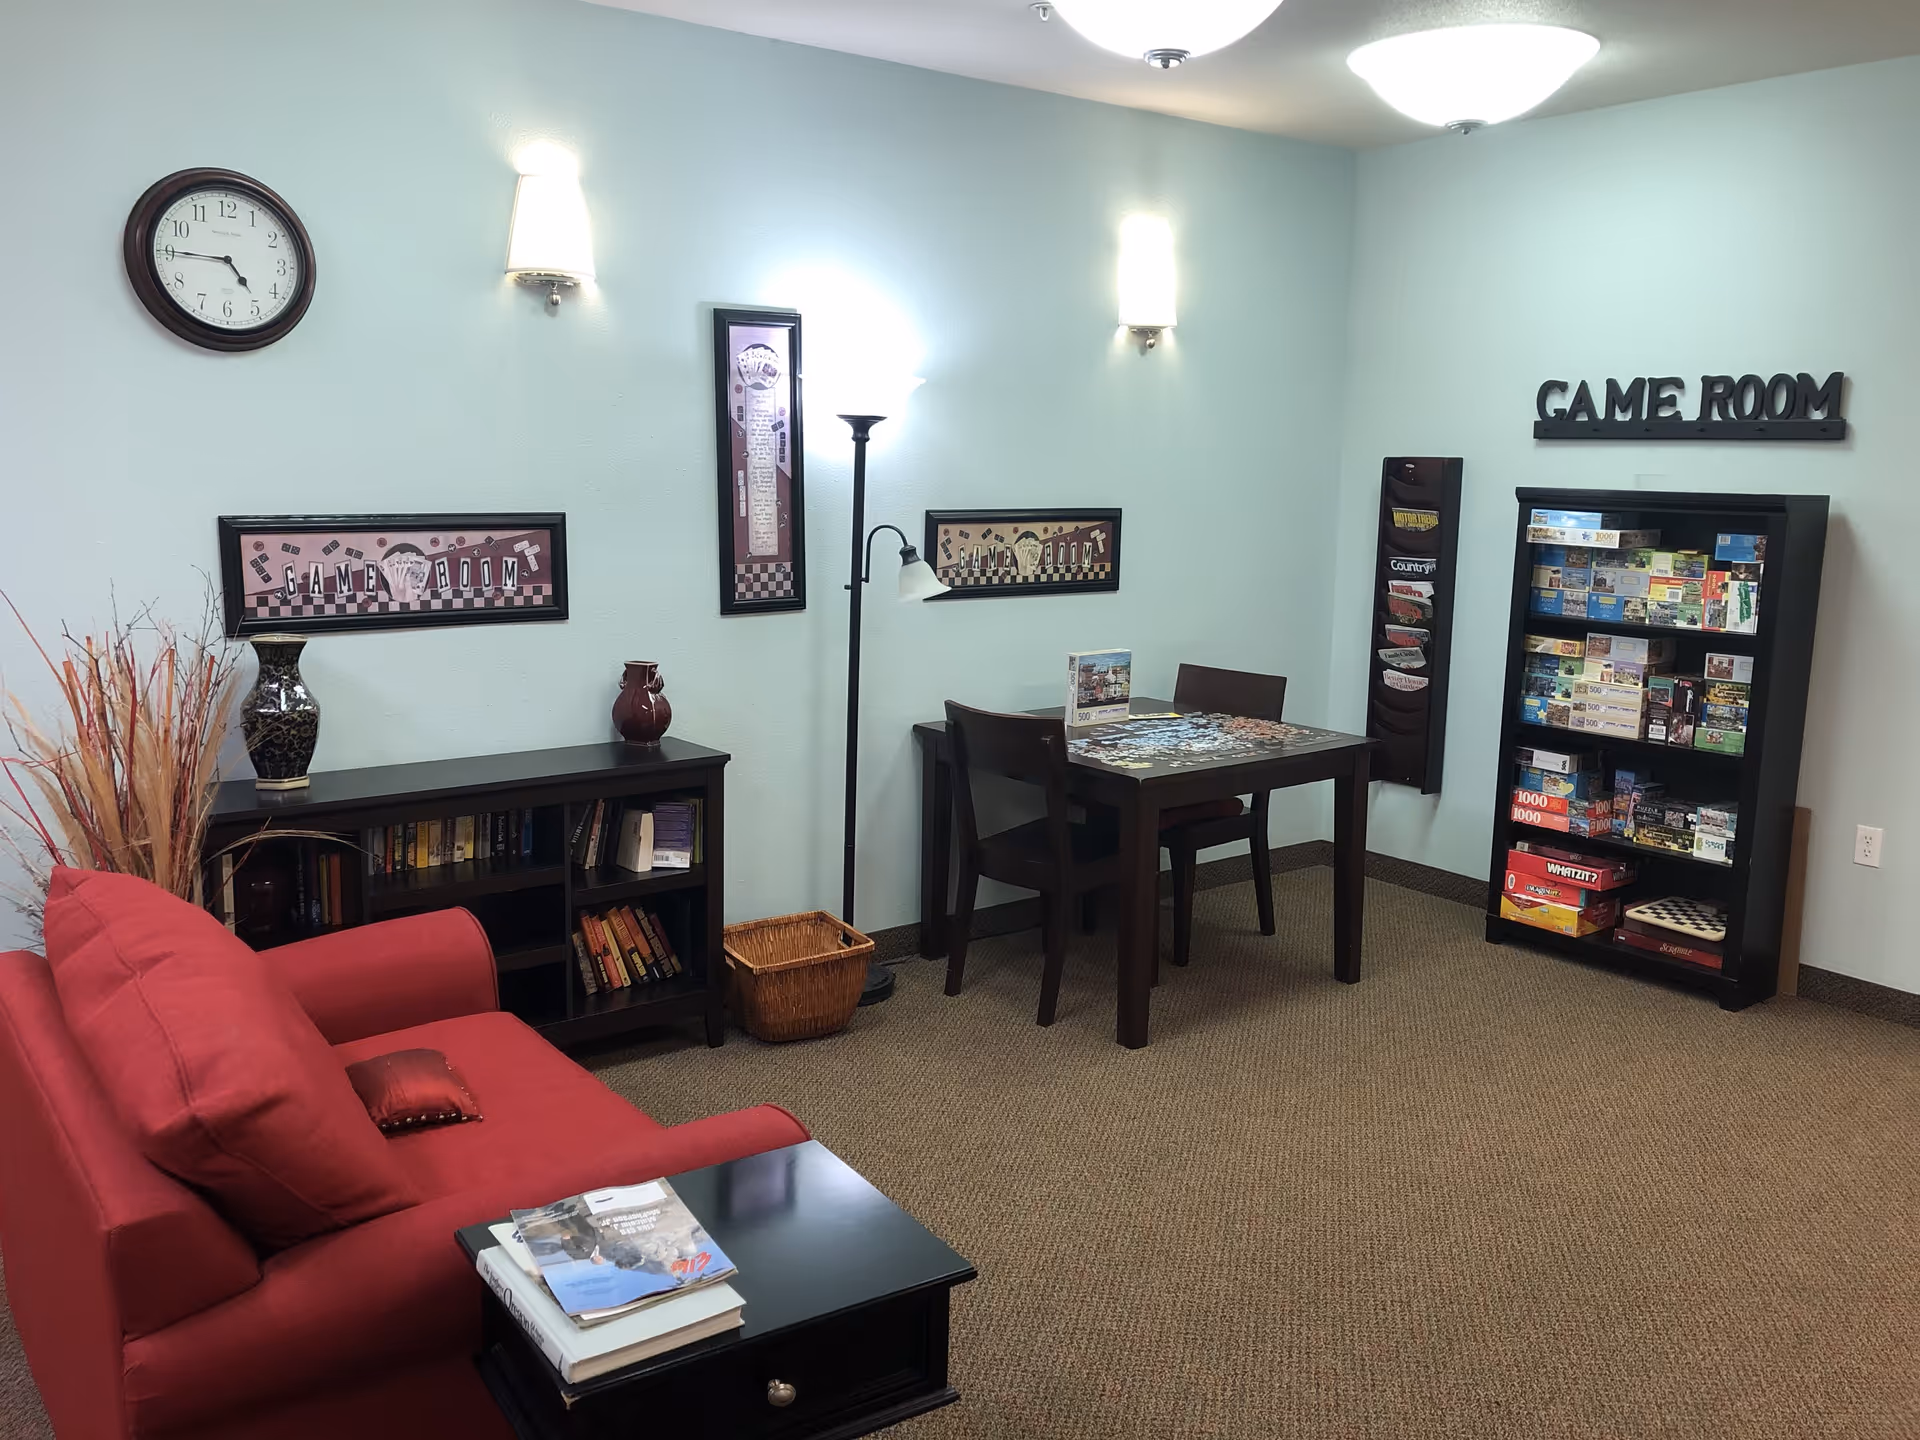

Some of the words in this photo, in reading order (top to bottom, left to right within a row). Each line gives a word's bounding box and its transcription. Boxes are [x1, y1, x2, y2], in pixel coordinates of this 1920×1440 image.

[192, 204, 208, 223] 11
[218, 200, 237, 219] 12
[248, 210, 257, 228] 1
[172, 220, 190, 239] 10
[267, 231, 278, 249] 2
[165, 244, 175, 263] 9
[276, 259, 287, 277] 3
[173, 271, 185, 290] 8
[268, 282, 280, 300] 4
[196, 292, 207, 310] 7
[222, 300, 233, 318] 6
[250, 299, 260, 317] 5
[1536, 376, 1685, 421] GAME
[1699, 371, 1845, 421] ROOM
[1393, 511, 1417, 523] MOTOR
[1595, 532, 1614, 543] 1000
[958, 544, 1012, 572] GAME
[1044, 541, 1093, 568] ROOM
[1390, 560, 1430, 575] Country
[283, 561, 376, 598] GAME
[435, 558, 519, 592] ROOM
[1589, 685, 1602, 694] 500
[1587, 702, 1600, 711] 500
[1078, 711, 1091, 722] 500
[1585, 718, 1598, 727] 500
[1517, 790, 1548, 808] 1000
[1513, 807, 1541, 824] 1000
[1545, 861, 1598, 884] WHATZIT?
